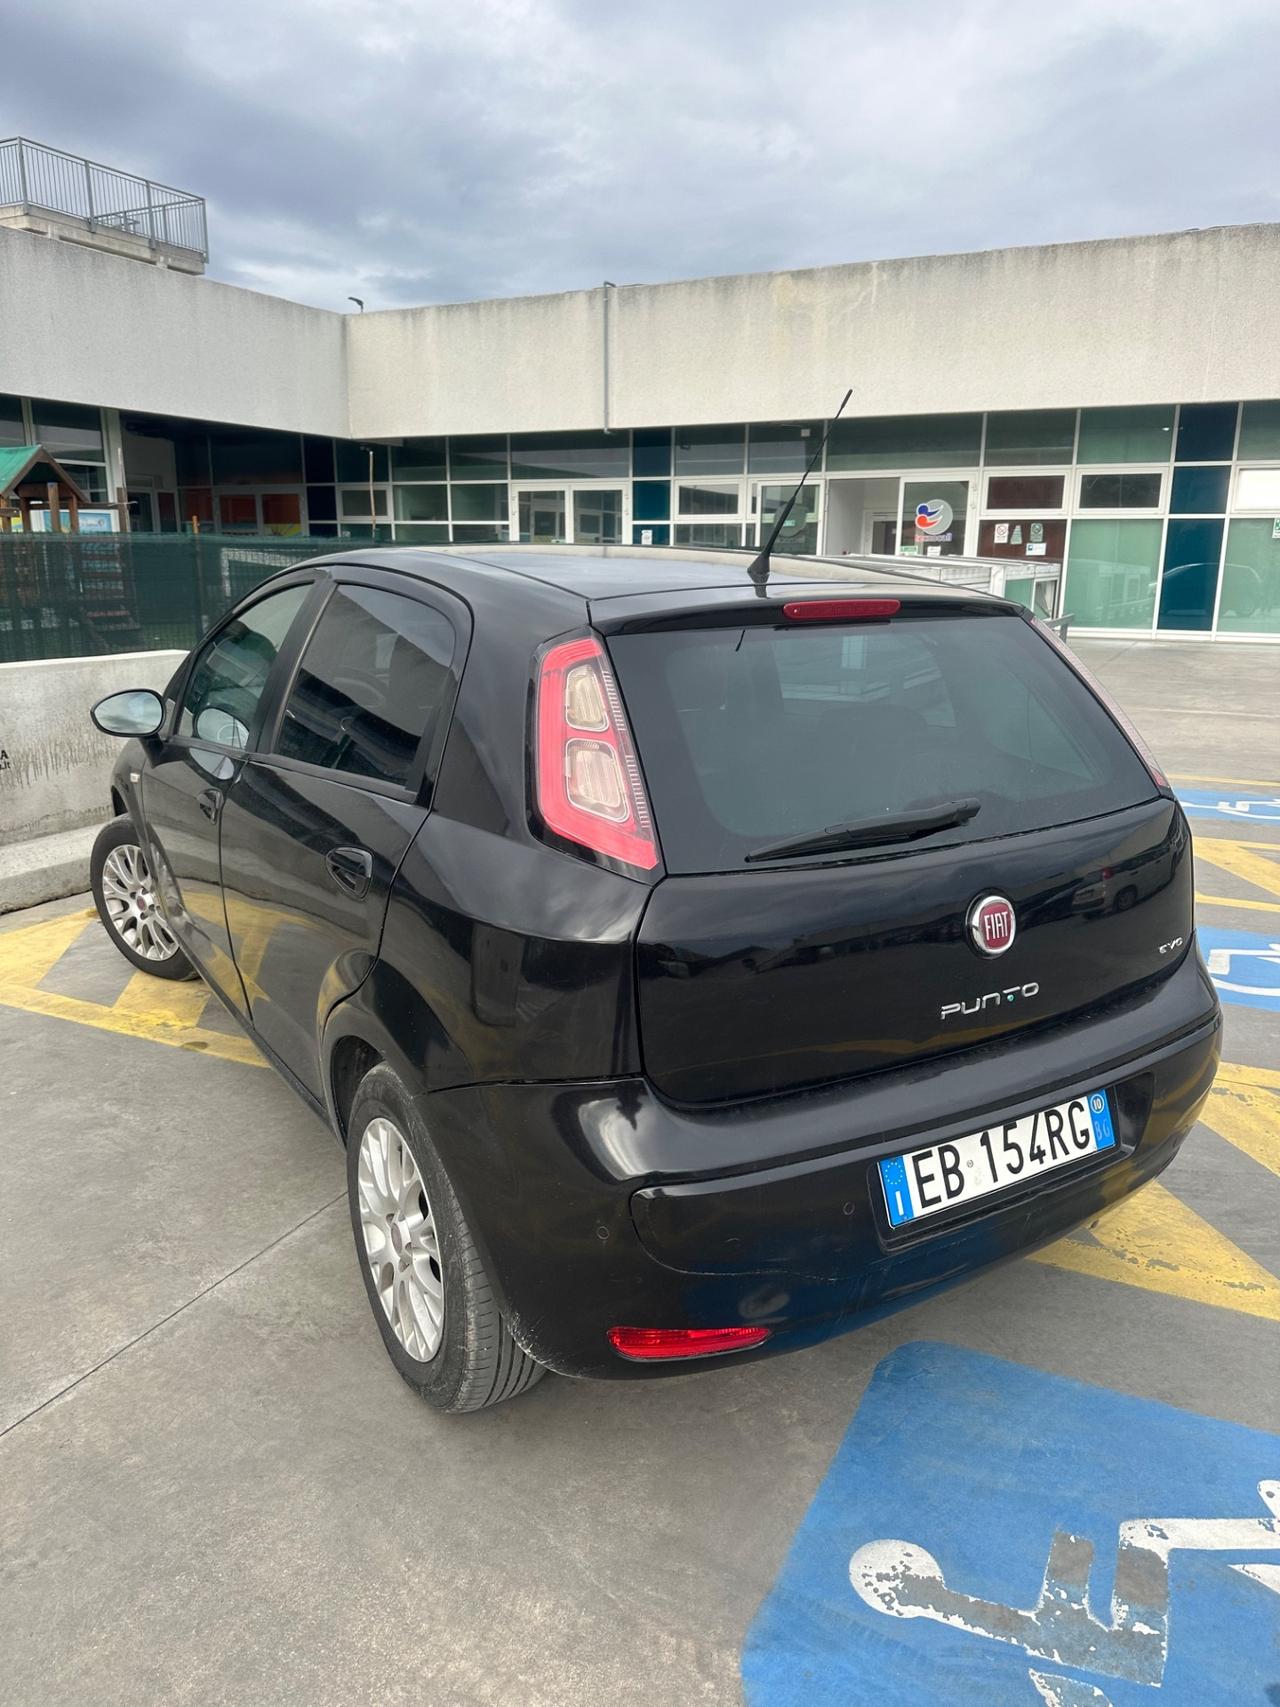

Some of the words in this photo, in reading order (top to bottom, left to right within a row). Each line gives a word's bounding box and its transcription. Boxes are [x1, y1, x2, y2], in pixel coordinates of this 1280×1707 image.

[983, 911, 1008, 941] FIAT
[1159, 936, 1183, 954] EVO
[940, 981, 1040, 1020] PUNTO
[1094, 1118, 1111, 1141] BG
[911, 1144, 965, 1209] EB
[979, 1100, 1091, 1183] 154RG
